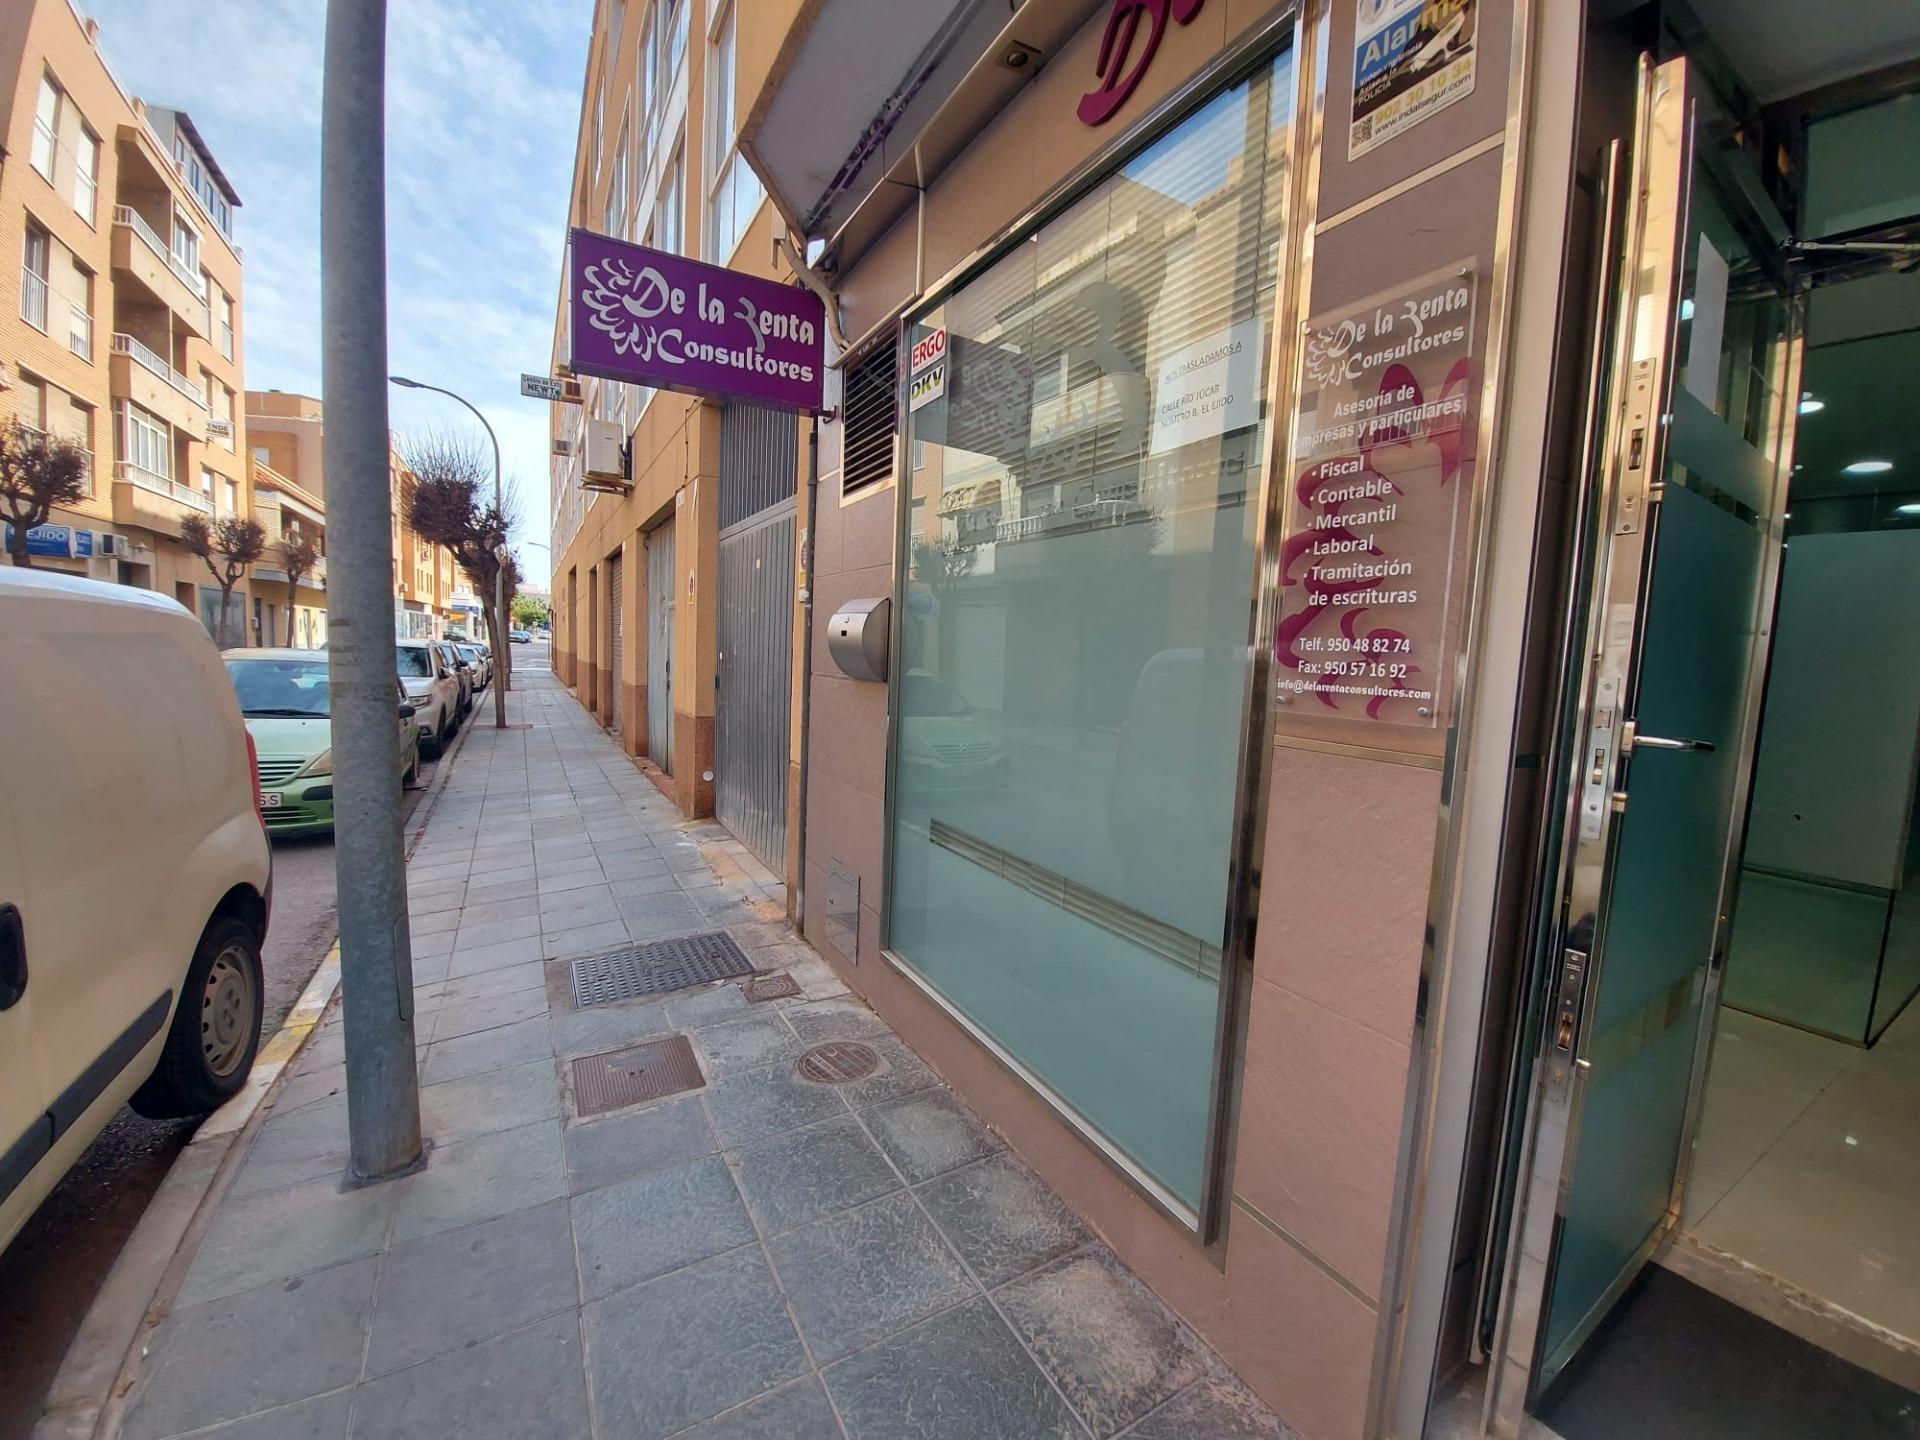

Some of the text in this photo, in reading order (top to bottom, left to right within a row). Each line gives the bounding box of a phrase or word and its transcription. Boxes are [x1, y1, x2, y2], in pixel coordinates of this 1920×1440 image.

[1375, 98, 1401, 126] 902
[1429, 71, 1447, 90] 10
[622, 266, 685, 318] De
[699, 283, 725, 325] la
[1327, 319, 1366, 358] De
[1374, 308, 1393, 336] la
[657, 328, 814, 383] Consultores
[912, 330, 945, 369] ERGO
[1180, 343, 1234, 374] TRASLADAMOS
[1236, 341, 1242, 351] A
[1345, 325, 1465, 379] Consultores
[911, 366, 944, 400] DKV
[1396, 384, 1415, 402] de
[1161, 398, 1181, 414] CALLE
[1201, 403, 1209, 414] EL
[1212, 394, 1234, 410] EJIDO
[1358, 421, 1367, 438] y
[1369, 398, 1461, 436] particulares
[1320, 455, 1364, 479] Fiscal
[1317, 478, 1393, 505] Contable
[1315, 504, 1397, 531] Mercantil
[1313, 534, 1374, 556] Laboral
[1311, 559, 1412, 581] Tramitación
[1309, 589, 1417, 606] de escrituras
[1299, 637, 1410, 654] Telf. 950 48 82 74
[1298, 661, 1407, 679] Fax: 950 57 16 92
[1277, 679, 1431, 700] info@delarentaconsultores.com
